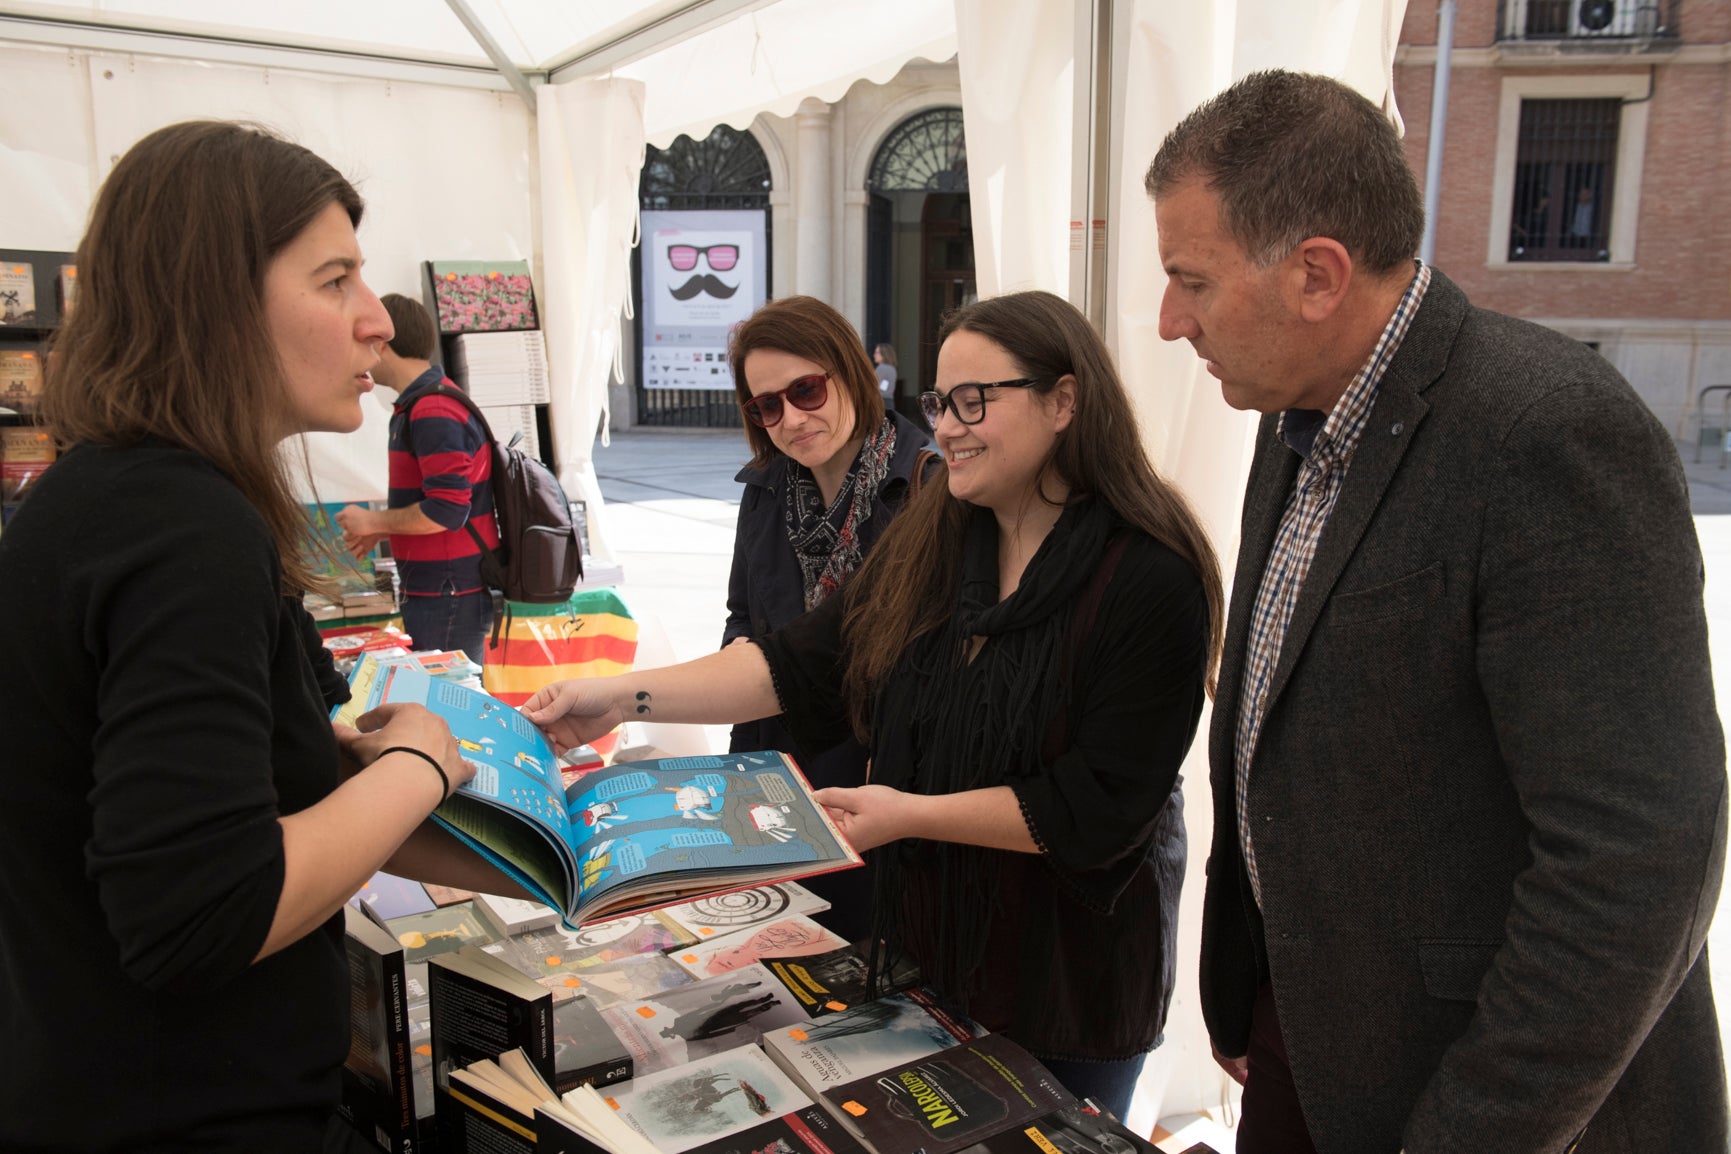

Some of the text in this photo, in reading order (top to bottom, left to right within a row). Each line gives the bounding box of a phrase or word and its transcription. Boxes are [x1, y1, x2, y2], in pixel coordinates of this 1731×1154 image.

[392, 974, 401, 1012] CERVANTES
[396, 1042, 405, 1063] color
[809, 1045, 842, 1080] venganza
[397, 1064, 406, 1074] de
[810, 1058, 833, 1082] Aguas
[400, 1076, 409, 1109] minutos
[898, 1070, 961, 1130] NARCOLEPSIA
[937, 1085, 957, 1104] LEDESMA
[401, 1111, 410, 1129] Tres
[954, 1104, 968, 1118] JORDI
